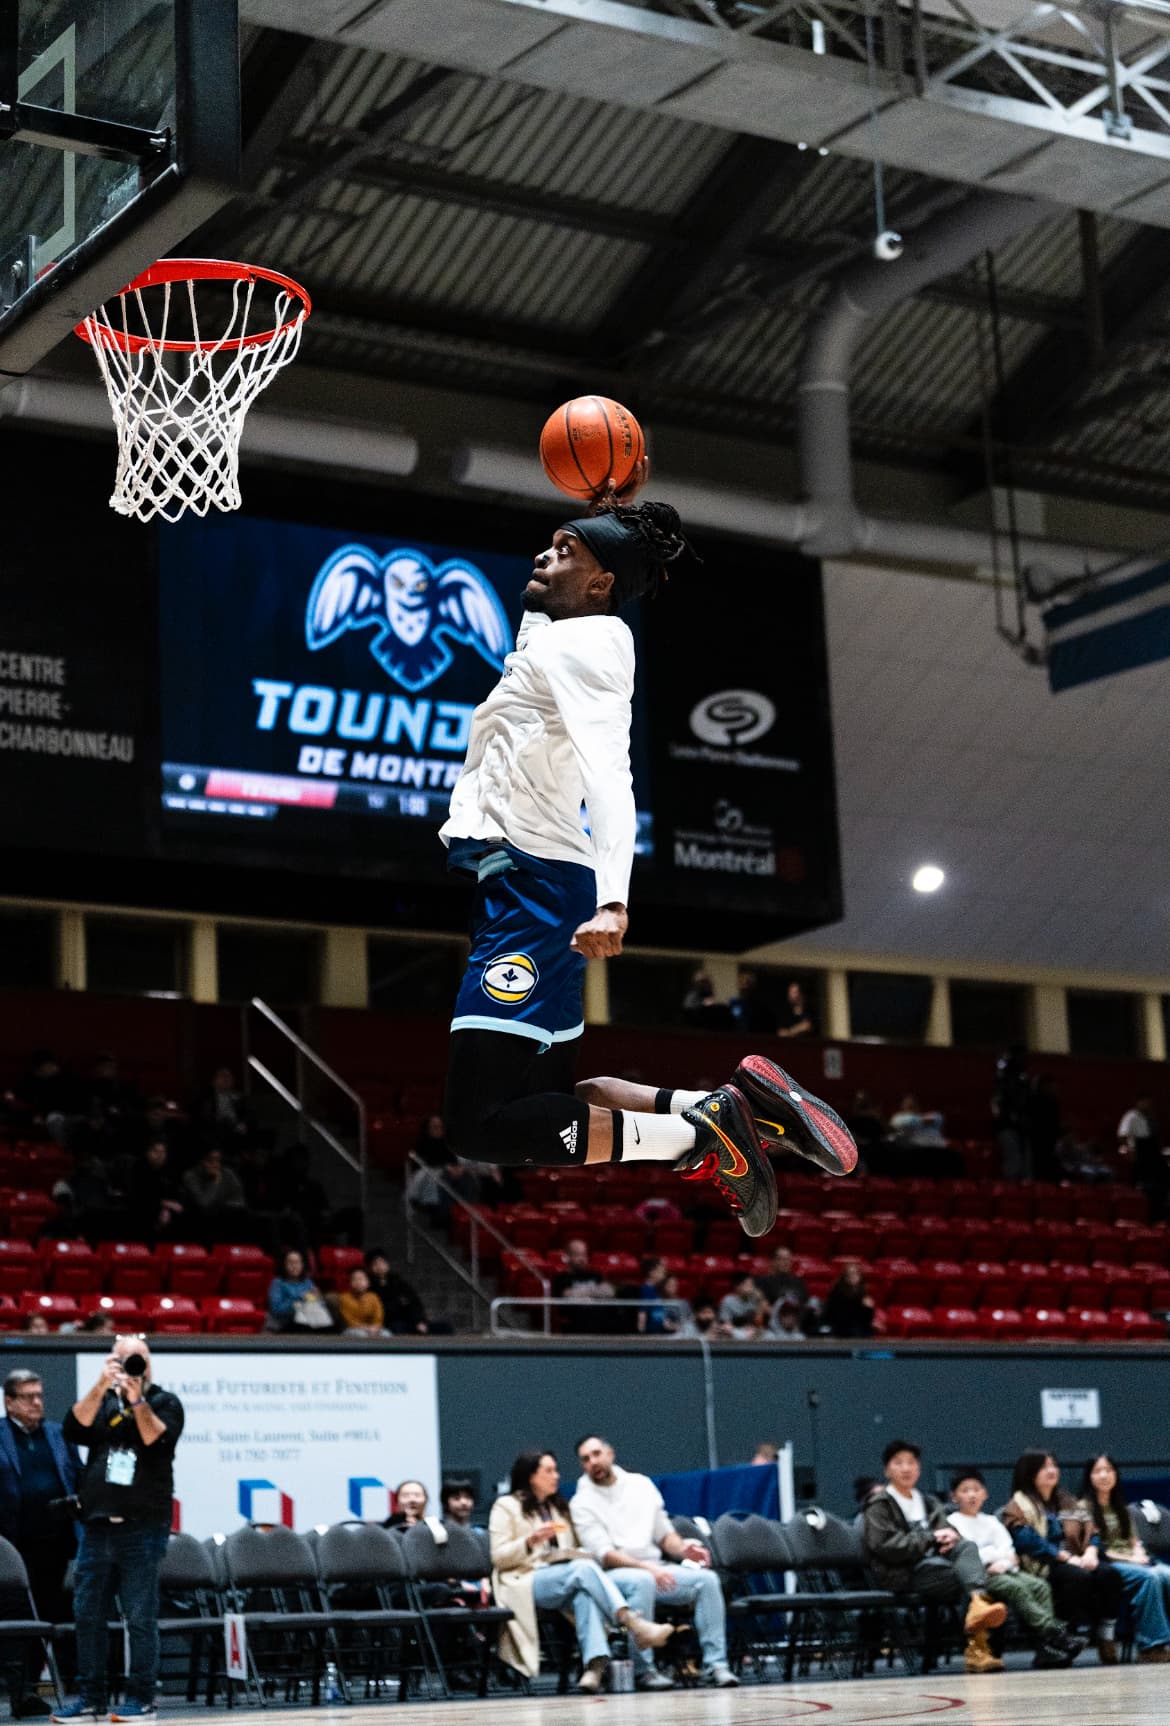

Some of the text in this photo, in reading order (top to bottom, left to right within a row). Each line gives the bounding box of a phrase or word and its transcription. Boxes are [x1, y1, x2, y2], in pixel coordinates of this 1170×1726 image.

[0, 652, 65, 685] CENTRE
[0, 721, 134, 763] CHARBONNEAU
[298, 745, 347, 776] DE
[570, 1120, 578, 1154] adidas
